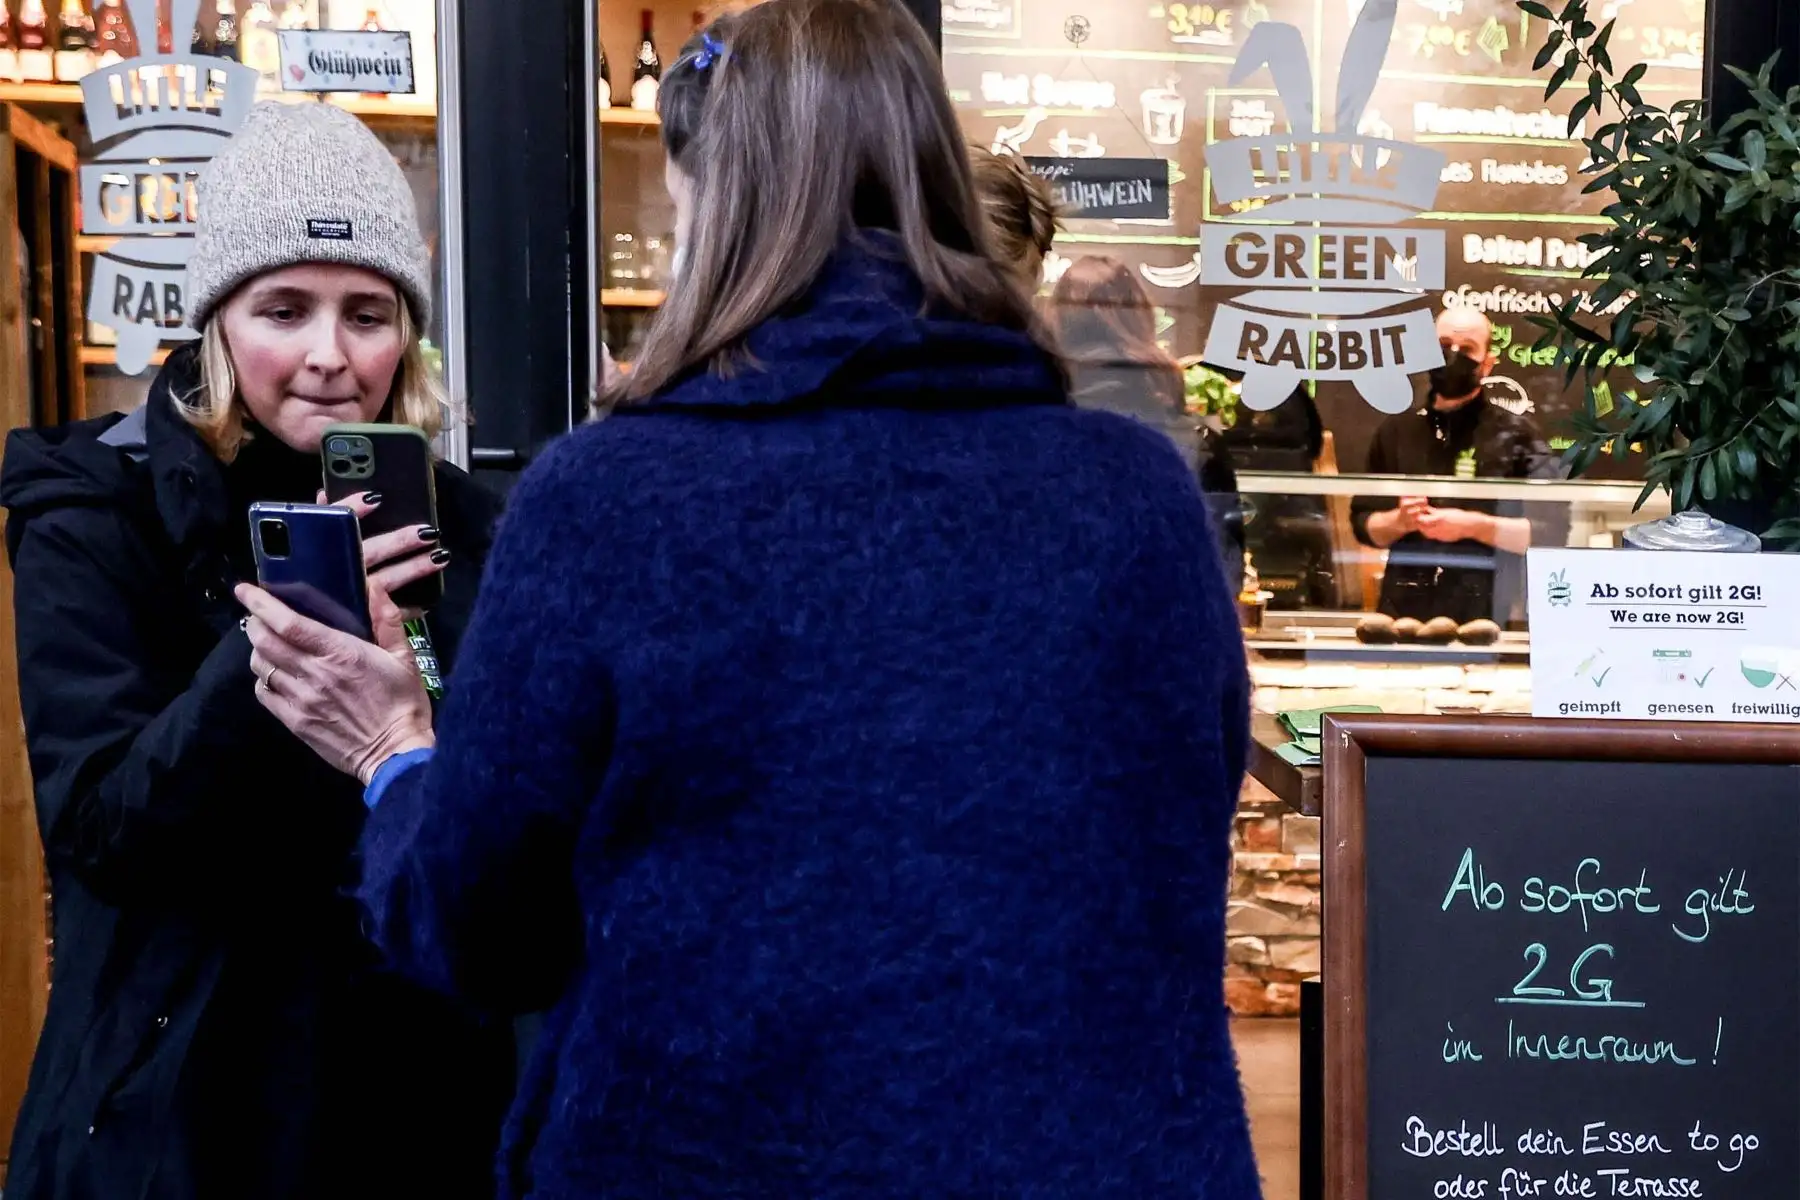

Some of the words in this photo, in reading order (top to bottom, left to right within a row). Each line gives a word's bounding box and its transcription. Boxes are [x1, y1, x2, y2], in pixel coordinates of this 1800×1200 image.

[308, 50, 402, 81] Glühwein
[108, 64, 227, 120] LITTLE
[1249, 142, 1398, 191] LITTLE
[1224, 231, 1417, 281] GREEN
[1462, 233, 1543, 267] Baked
[112, 273, 186, 328] RAB
[1236, 320, 1407, 371] RABBIT
[1591, 584, 1619, 599] Ab
[1625, 583, 1683, 600] sofort
[1689, 585, 1723, 603] gilt
[1728, 585, 1762, 600] 2G!
[1611, 610, 1638, 623] We
[1642, 612, 1672, 624] are
[1676, 612, 1712, 624] now
[1716, 612, 1744, 624] 2G!
[1559, 700, 1622, 714] geimpft
[1647, 703, 1715, 714] genesen
[1732, 702, 1800, 718] freiwillig
[1442, 848, 1504, 911] Ab
[1521, 858, 1660, 932] sofort
[1672, 868, 1755, 942] gilt
[1513, 943, 1615, 1002] 2G
[1442, 1021, 1482, 1062] im
[1508, 1019, 1696, 1065] Innenraum
[1401, 1115, 1504, 1157] Bestell
[1517, 1128, 1574, 1155] dein
[1582, 1121, 1671, 1154] Essen
[1688, 1120, 1720, 1151] to
[1717, 1135, 1760, 1172] go
[1434, 1171, 1489, 1199] oder
[1498, 1168, 1548, 1200] für
[1554, 1168, 1597, 1198] die
[1597, 1168, 1703, 1198] Terrasse
